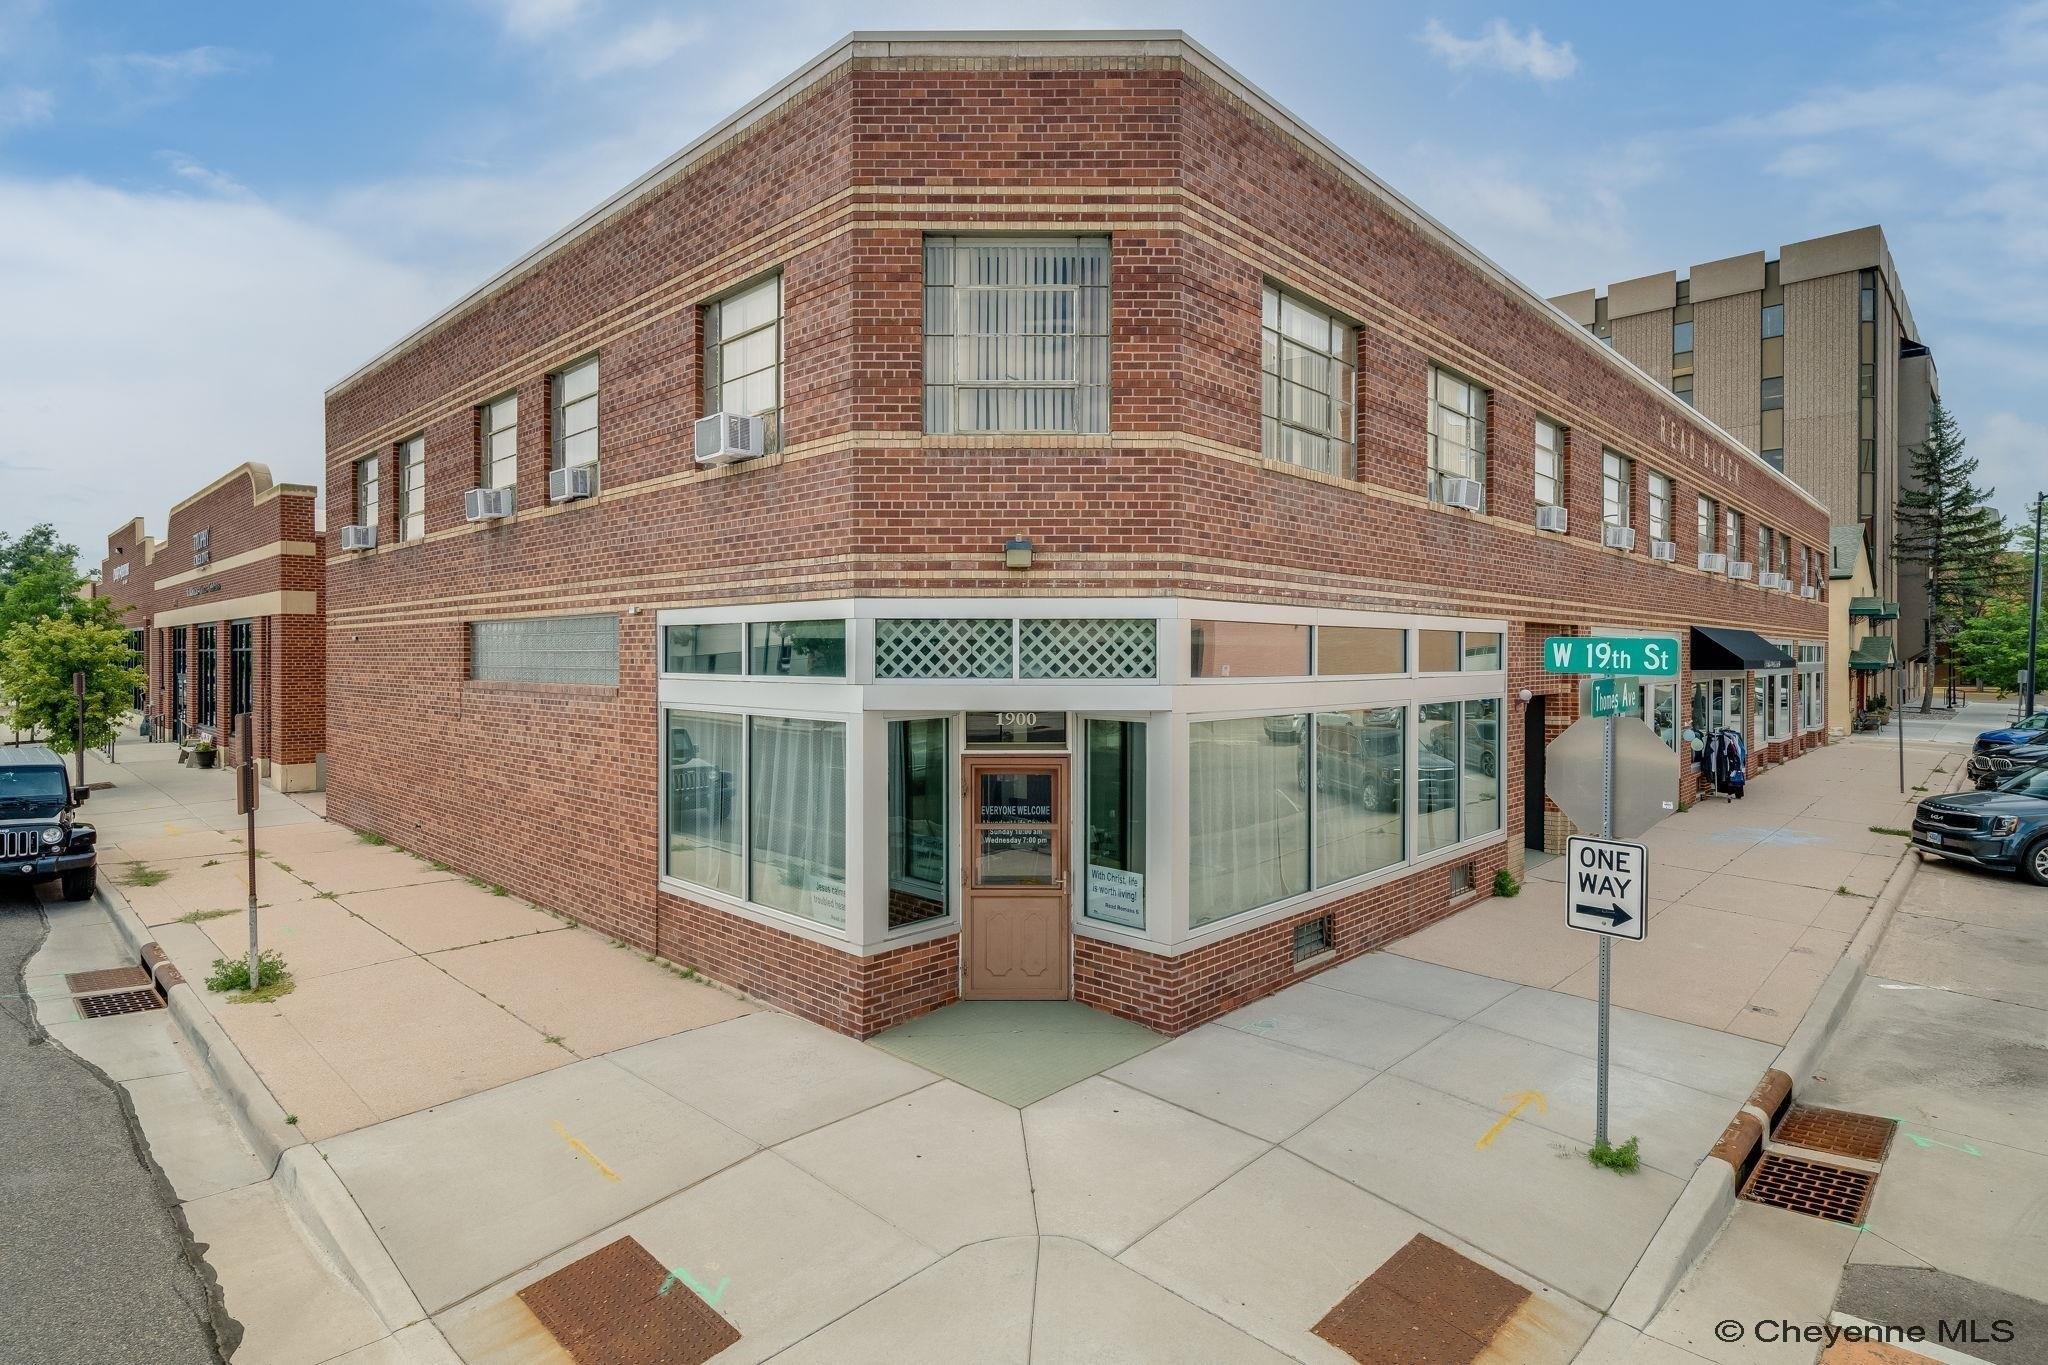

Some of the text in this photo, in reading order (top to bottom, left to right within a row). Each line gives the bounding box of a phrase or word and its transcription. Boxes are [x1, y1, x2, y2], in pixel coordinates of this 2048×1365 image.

[1660, 414, 1740, 486] READ BLOCK
[1552, 643, 1669, 670] W 19th St
[1621, 682, 1636, 707] Ave
[995, 712, 1037, 726] 1900
[981, 805, 1051, 815] EVERYONE WELCOME
[984, 836, 1022, 845] Wednesday
[1023, 836, 1037, 844] 7:00
[1580, 846, 1631, 874] ONE
[1091, 869, 1106, 881] With
[1129, 876, 1139, 887] life
[1578, 871, 1632, 899] WAY
[1092, 882, 1098, 893] is
[1099, 885, 1117, 897] worth
